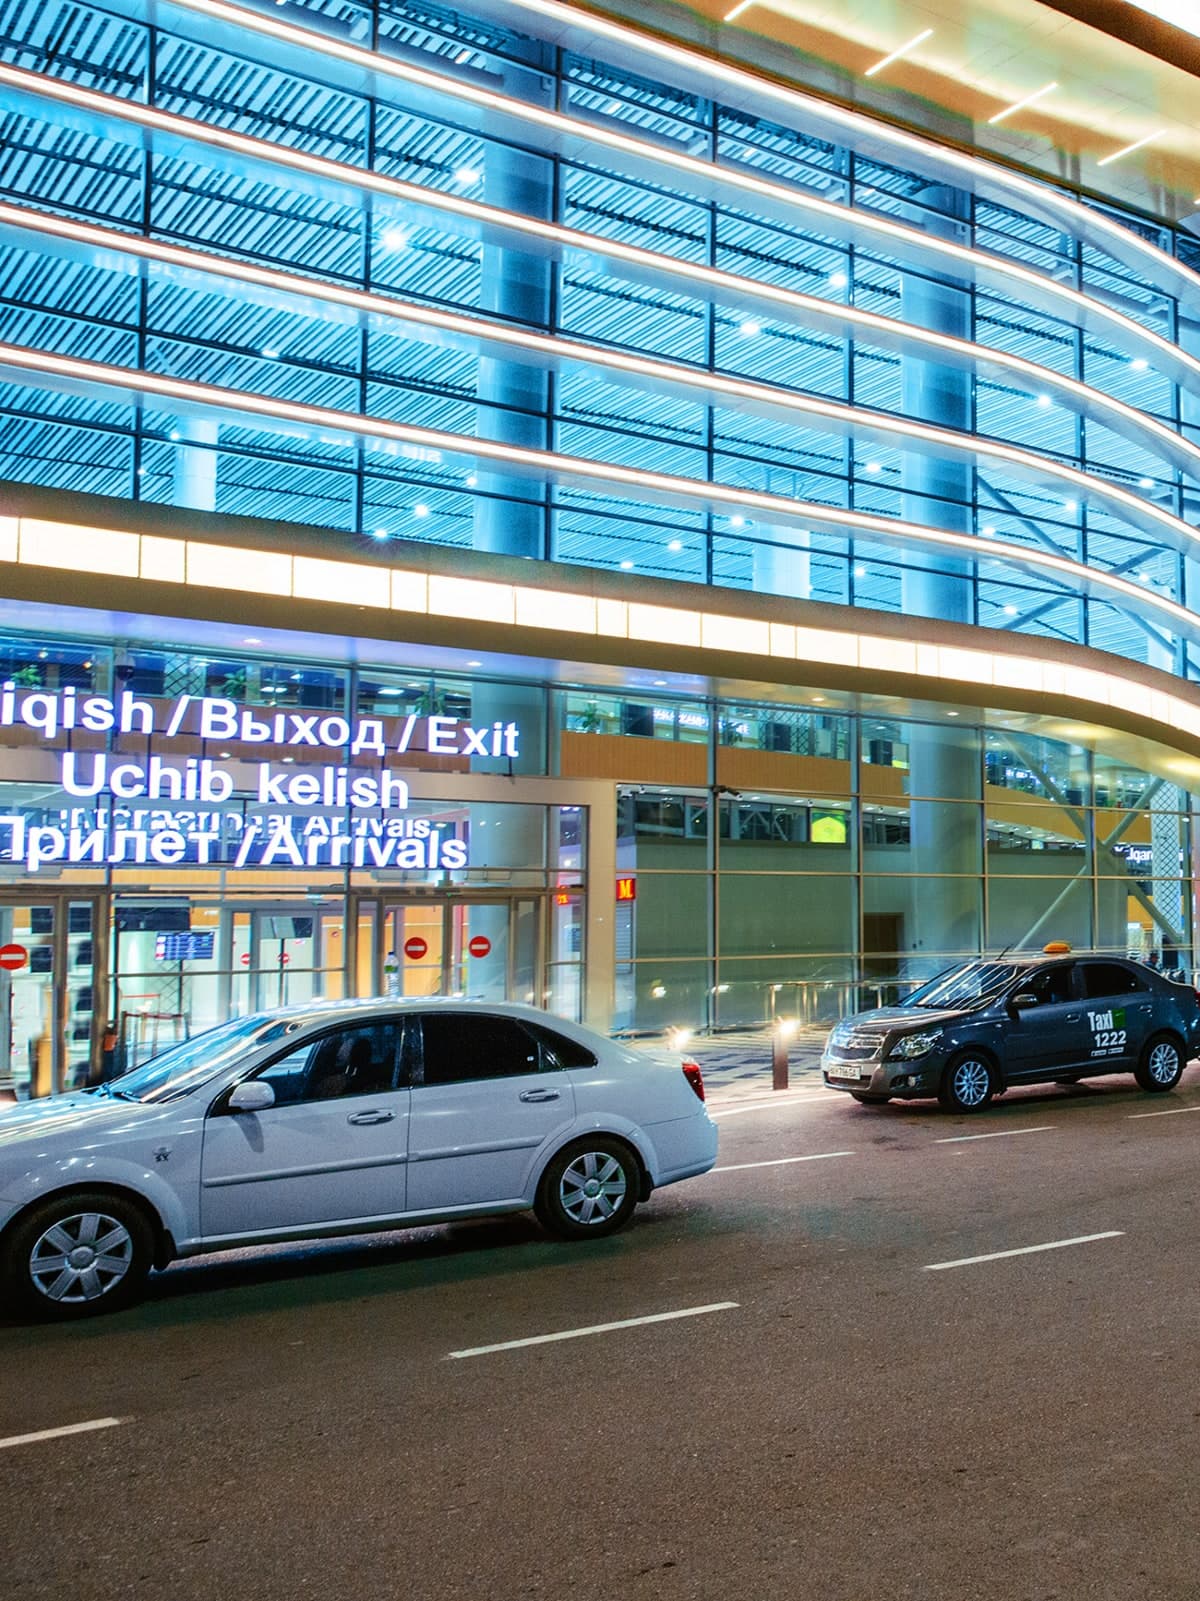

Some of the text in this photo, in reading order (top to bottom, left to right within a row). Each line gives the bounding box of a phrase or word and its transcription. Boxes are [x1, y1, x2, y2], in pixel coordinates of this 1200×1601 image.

[1, 681, 153, 738] iqish
[200, 697, 386, 756] Выход
[427, 715, 519, 757] Exit
[62, 752, 408, 809] Uchib kelish
[260, 826, 468, 869] Arrivals
[1087, 1010, 1114, 1031] Taxi
[1094, 1030, 1127, 1047] 1222
